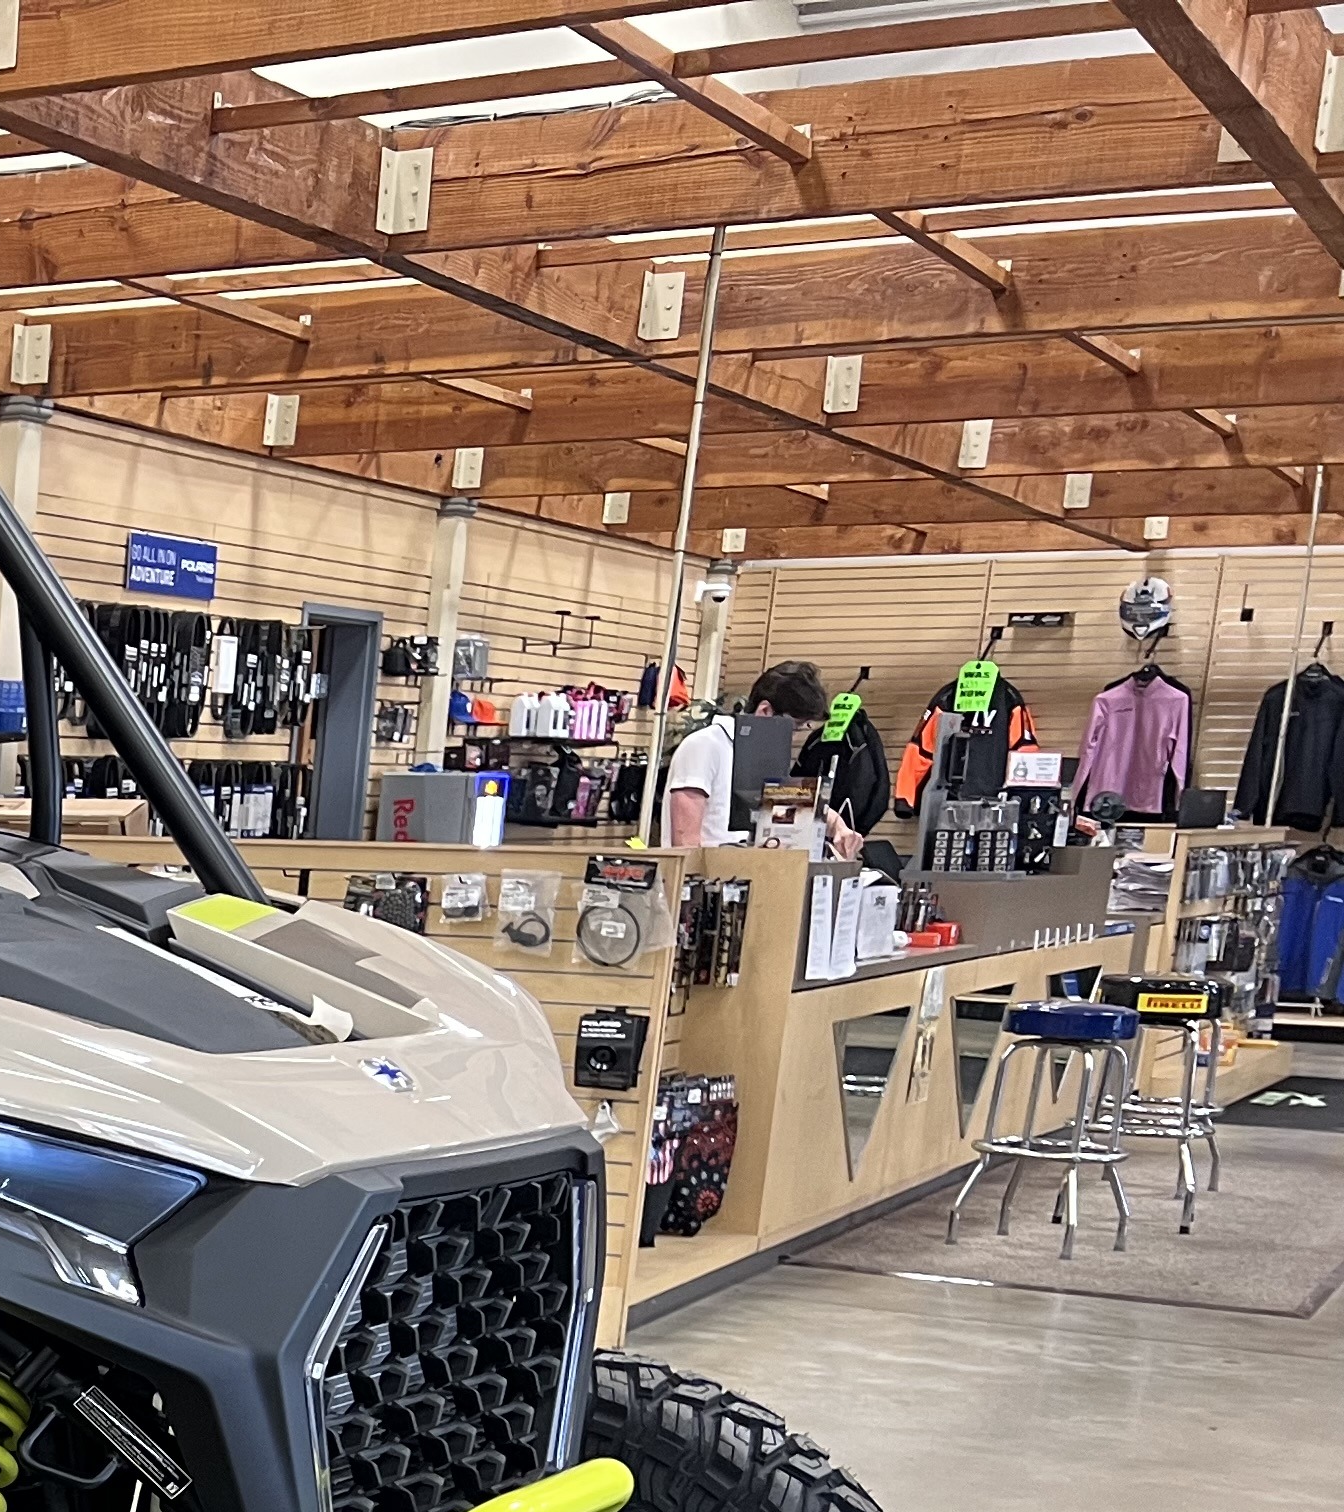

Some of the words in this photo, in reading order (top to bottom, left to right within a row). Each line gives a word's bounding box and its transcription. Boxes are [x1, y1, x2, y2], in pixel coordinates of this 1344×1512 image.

[143, 546, 156, 564] ALL
[157, 548, 166, 564] IN
[166, 549, 177, 567] ON
[180, 558, 215, 574] POLARIS
[130, 565, 175, 586] ADVENTURE
[1146, 996, 1203, 1009] PIRELLI
